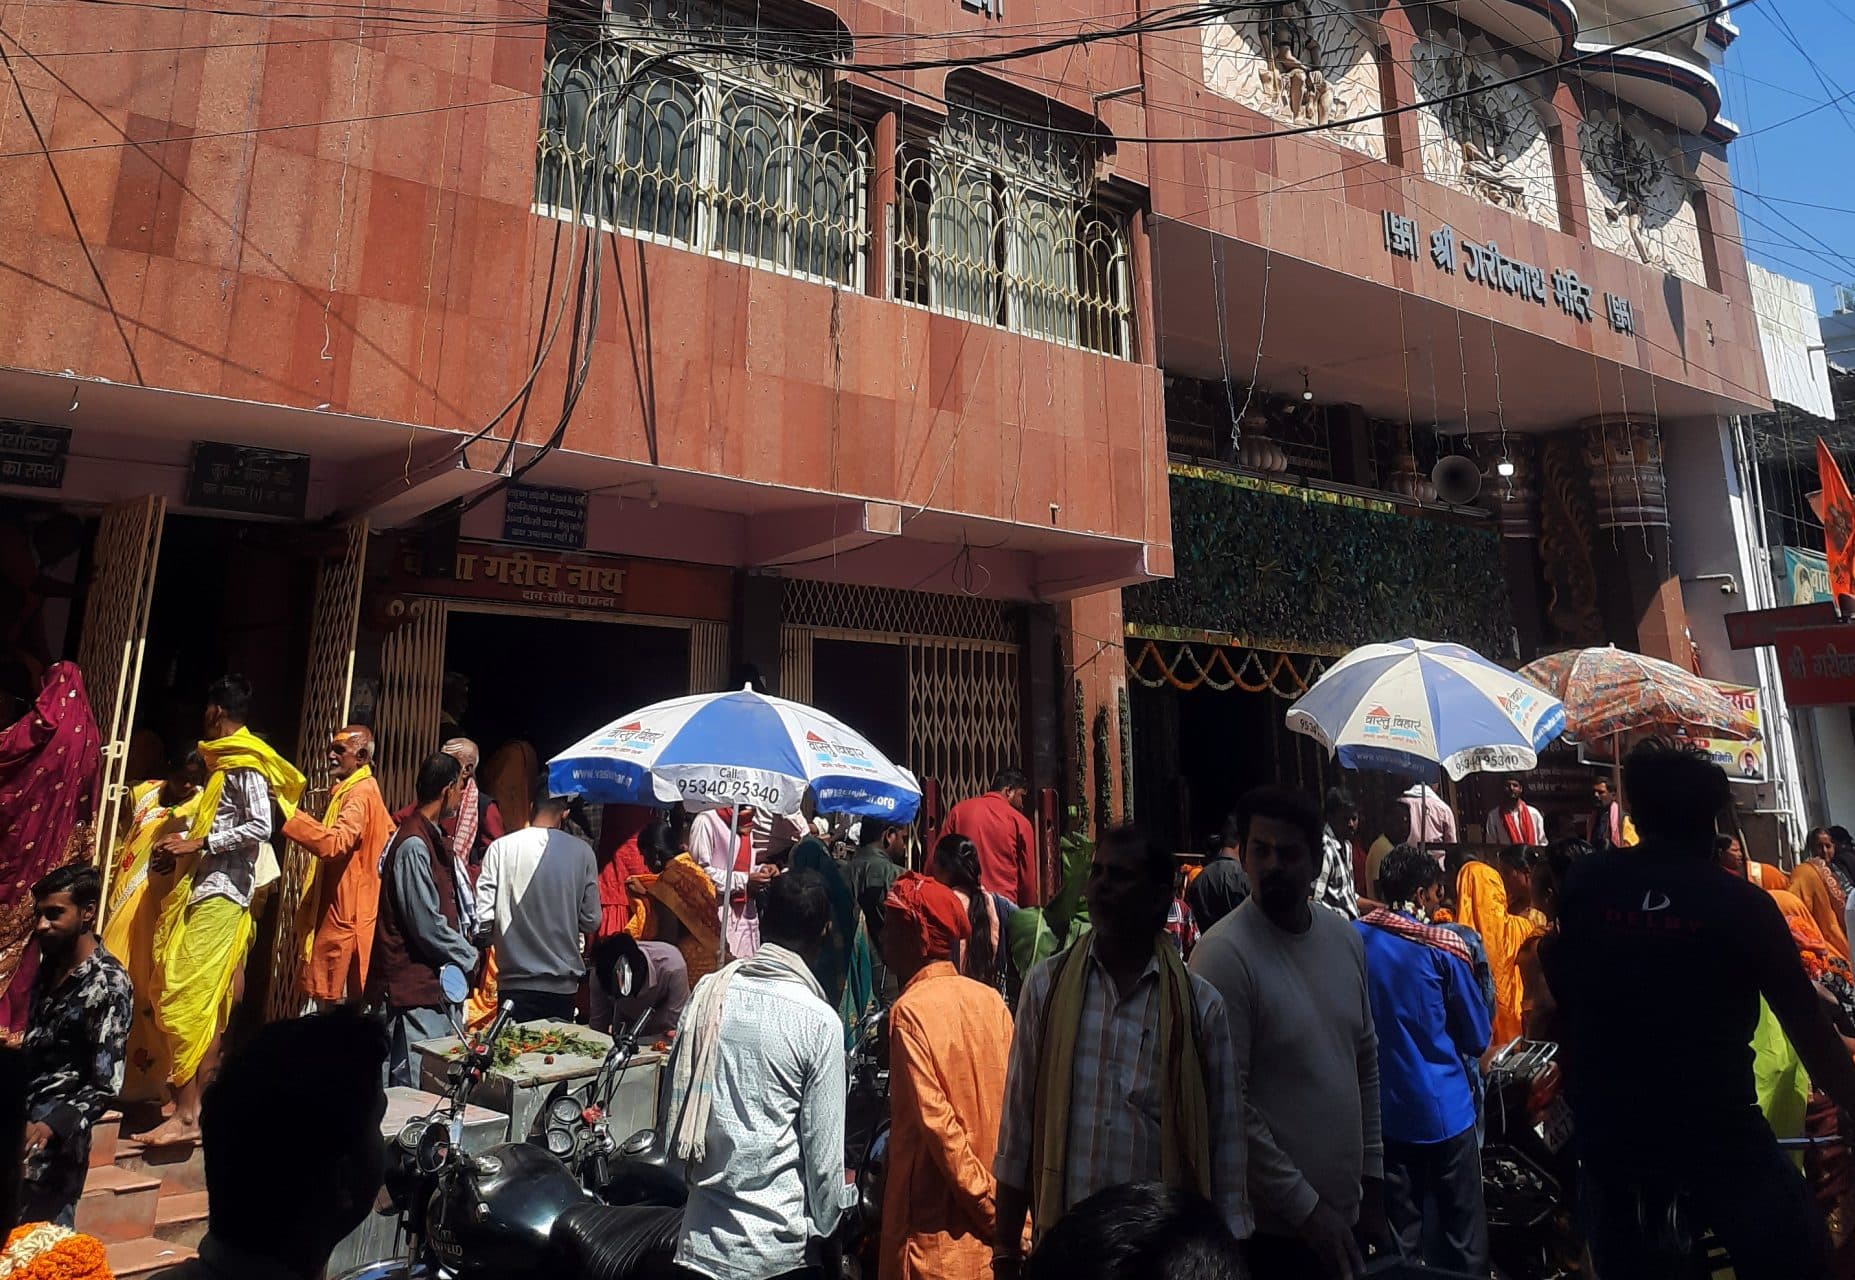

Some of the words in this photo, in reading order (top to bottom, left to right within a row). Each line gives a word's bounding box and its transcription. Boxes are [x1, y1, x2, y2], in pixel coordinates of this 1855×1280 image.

[1431, 224, 1456, 273] श्री
[1462, 240, 1546, 305] गरीबनाथ
[1551, 267, 1593, 322] मंदिर
[483, 552, 559, 590] गरीब
[566, 564, 627, 595] नाथ
[1393, 714, 1421, 731] विहार
[678, 779, 727, 795] 95340
[732, 781, 779, 804] 95340
